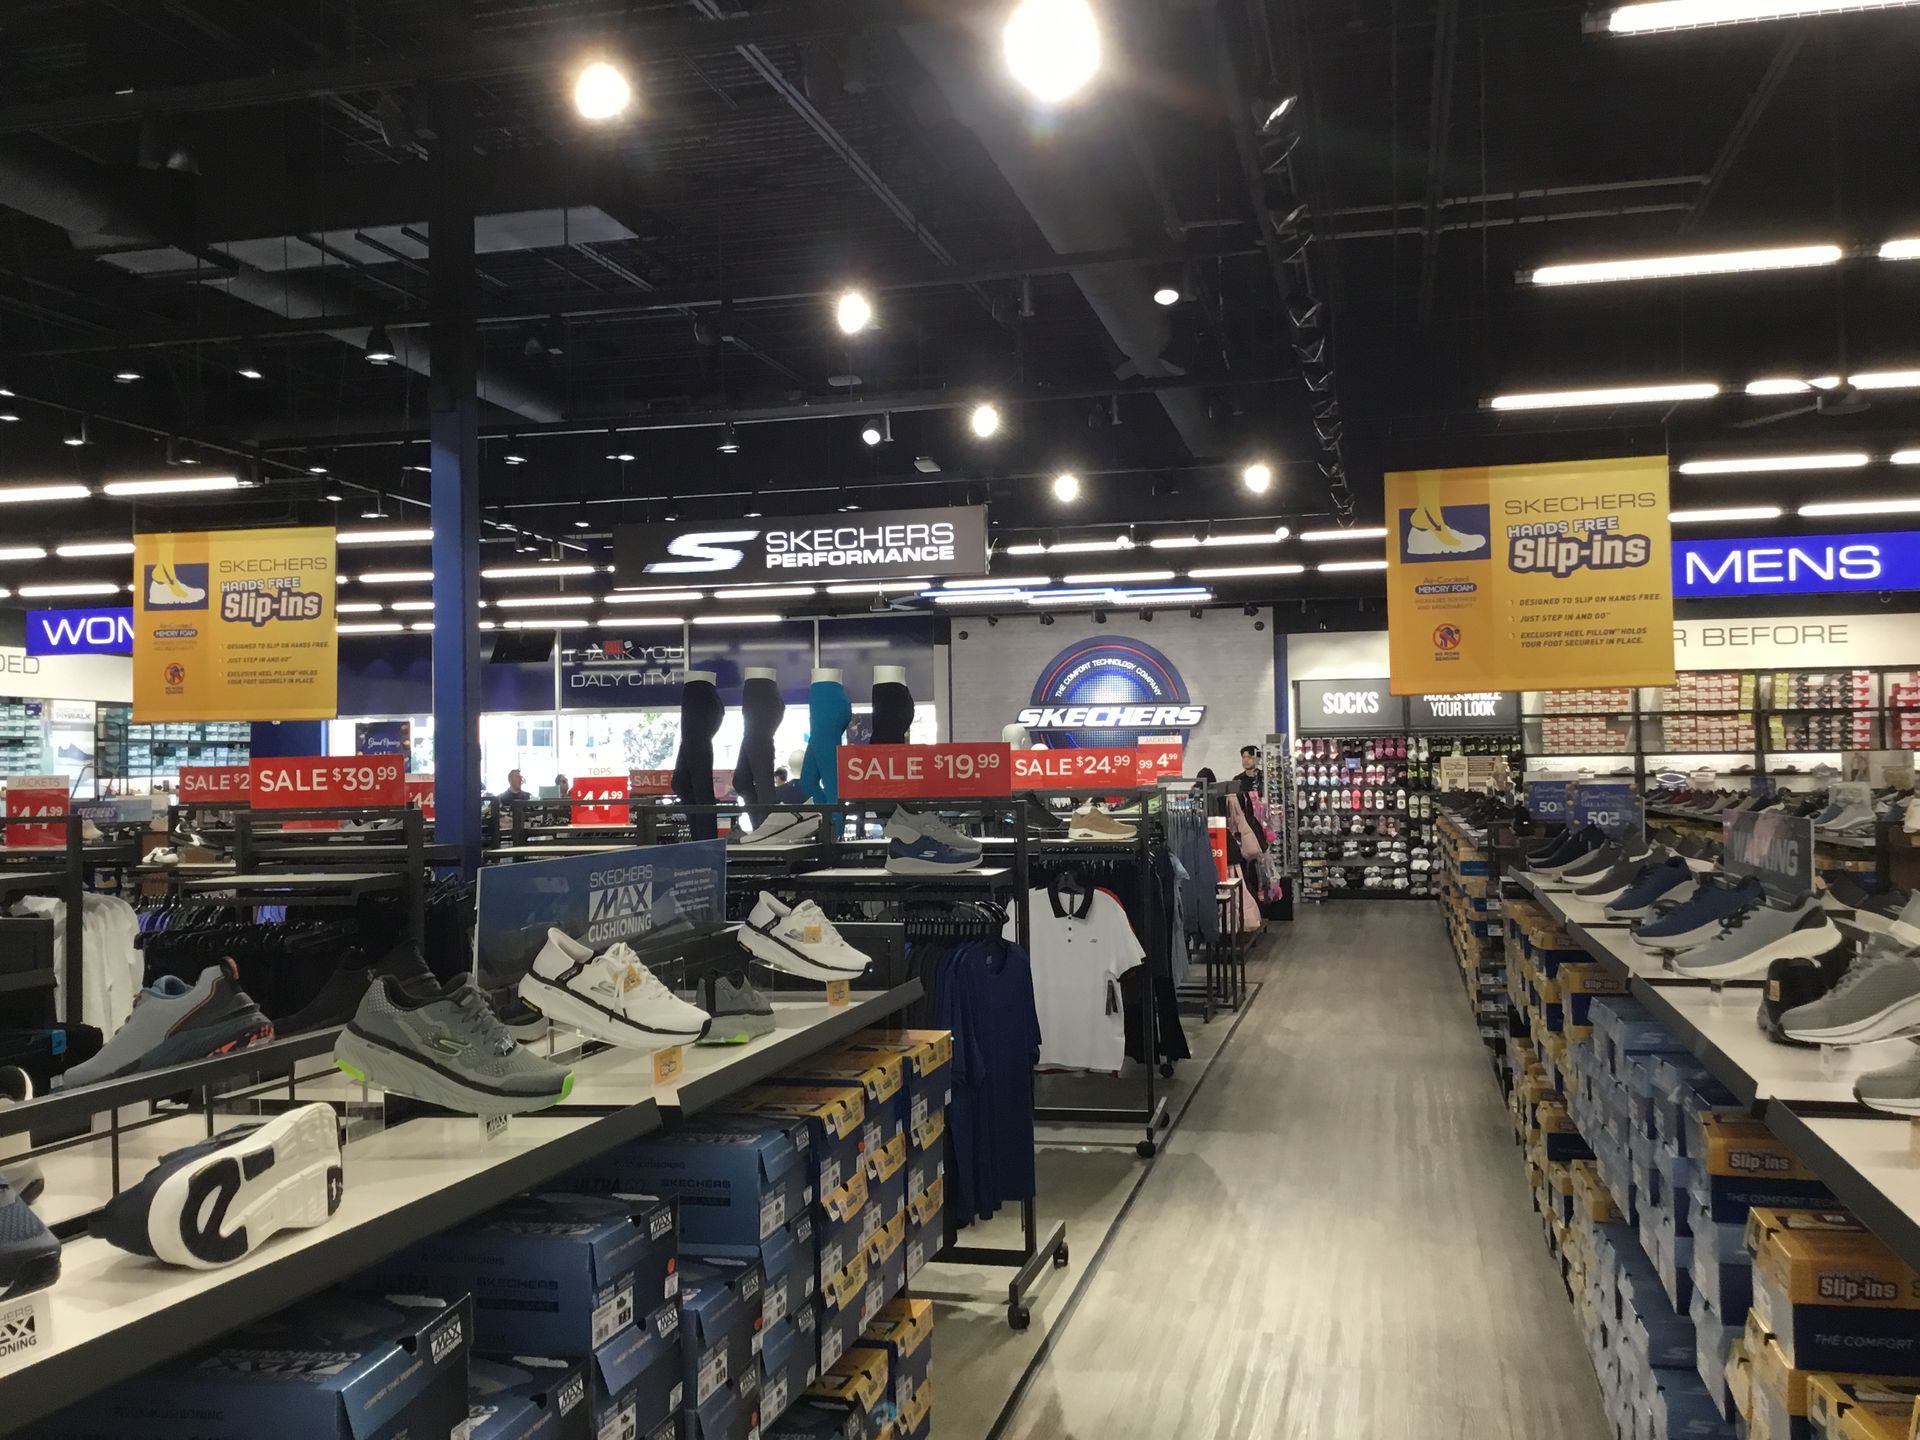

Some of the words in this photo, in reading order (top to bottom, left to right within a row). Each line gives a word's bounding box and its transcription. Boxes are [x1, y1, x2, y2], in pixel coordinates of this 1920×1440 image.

[1504, 492, 1656, 515] SKECHERS
[766, 523, 955, 553] SKECHERS
[1507, 520, 1568, 539] HANDS
[1573, 516, 1619, 533] FREE
[767, 546, 955, 569] PERFORMANCE
[1511, 532, 1648, 575] Slip-ins
[219, 557, 328, 573] SKECHERS
[1685, 544, 1881, 585] MENS
[221, 580, 265, 592] HANDS
[267, 577, 300, 590] FREE
[1418, 585, 1450, 593] MEMORY
[1451, 584, 1474, 592] FOAM
[222, 590, 320, 625] Slip-ins
[1519, 597, 1560, 606] DESIGNED
[1574, 596, 1593, 604] SLIP
[1608, 594, 1636, 602] HANDS
[1520, 615, 1540, 623] JUST
[1542, 614, 1563, 622] STEP
[1564, 613, 1574, 621] IN
[1520, 630, 1562, 639] EXCLUSIVE
[1564, 629, 1584, 637] HEEL
[1621, 627, 1647, 635] HOLDS
[1520, 640, 1541, 648] YOUR
[1543, 640, 1563, 648] FOOT
[1564, 638, 1603, 647] SECURELY
[1703, 624, 1849, 647] BEFORE
[638, 645, 684, 660] YOU
[0, 654, 40, 674] ED
[571, 674, 625, 688] DALY
[628, 672, 676, 686] CITY!
[1055, 684, 1066, 698] THE
[1063, 662, 1091, 686] COMFORT
[1092, 658, 1137, 671] TECHNOLOGY
[1136, 667, 1162, 696] COMPANY
[1322, 691, 1379, 714] SOCKS
[1430, 700, 1462, 717] YOUR
[1464, 700, 1496, 717] LOOK
[1017, 706, 1205, 727] SKECHERS
[587, 767, 612, 776] TOPS
[847, 757, 924, 781] SALE
[933, 753, 1000, 779] $19.99
[1015, 758, 1073, 777] SALE
[1076, 755, 1130, 774] $24.99
[15, 777, 61, 788] JACKETS
[184, 774, 231, 791] SALE
[259, 768, 328, 793] SALE
[332, 766, 398, 791] $39.99
[633, 774, 669, 787] SALE
[589, 864, 653, 889] SKECHERS
[588, 881, 653, 922] MAX
[588, 913, 652, 944] CUSHIONING
[1729, 1152, 1791, 1172] Slip-ins
[1820, 1278, 1896, 1300] Slip-ins
[431, 1320, 462, 1356] MAX
[1814, 1334, 1843, 1346] THE
[1843, 1336, 1914, 1350] COMFORT
